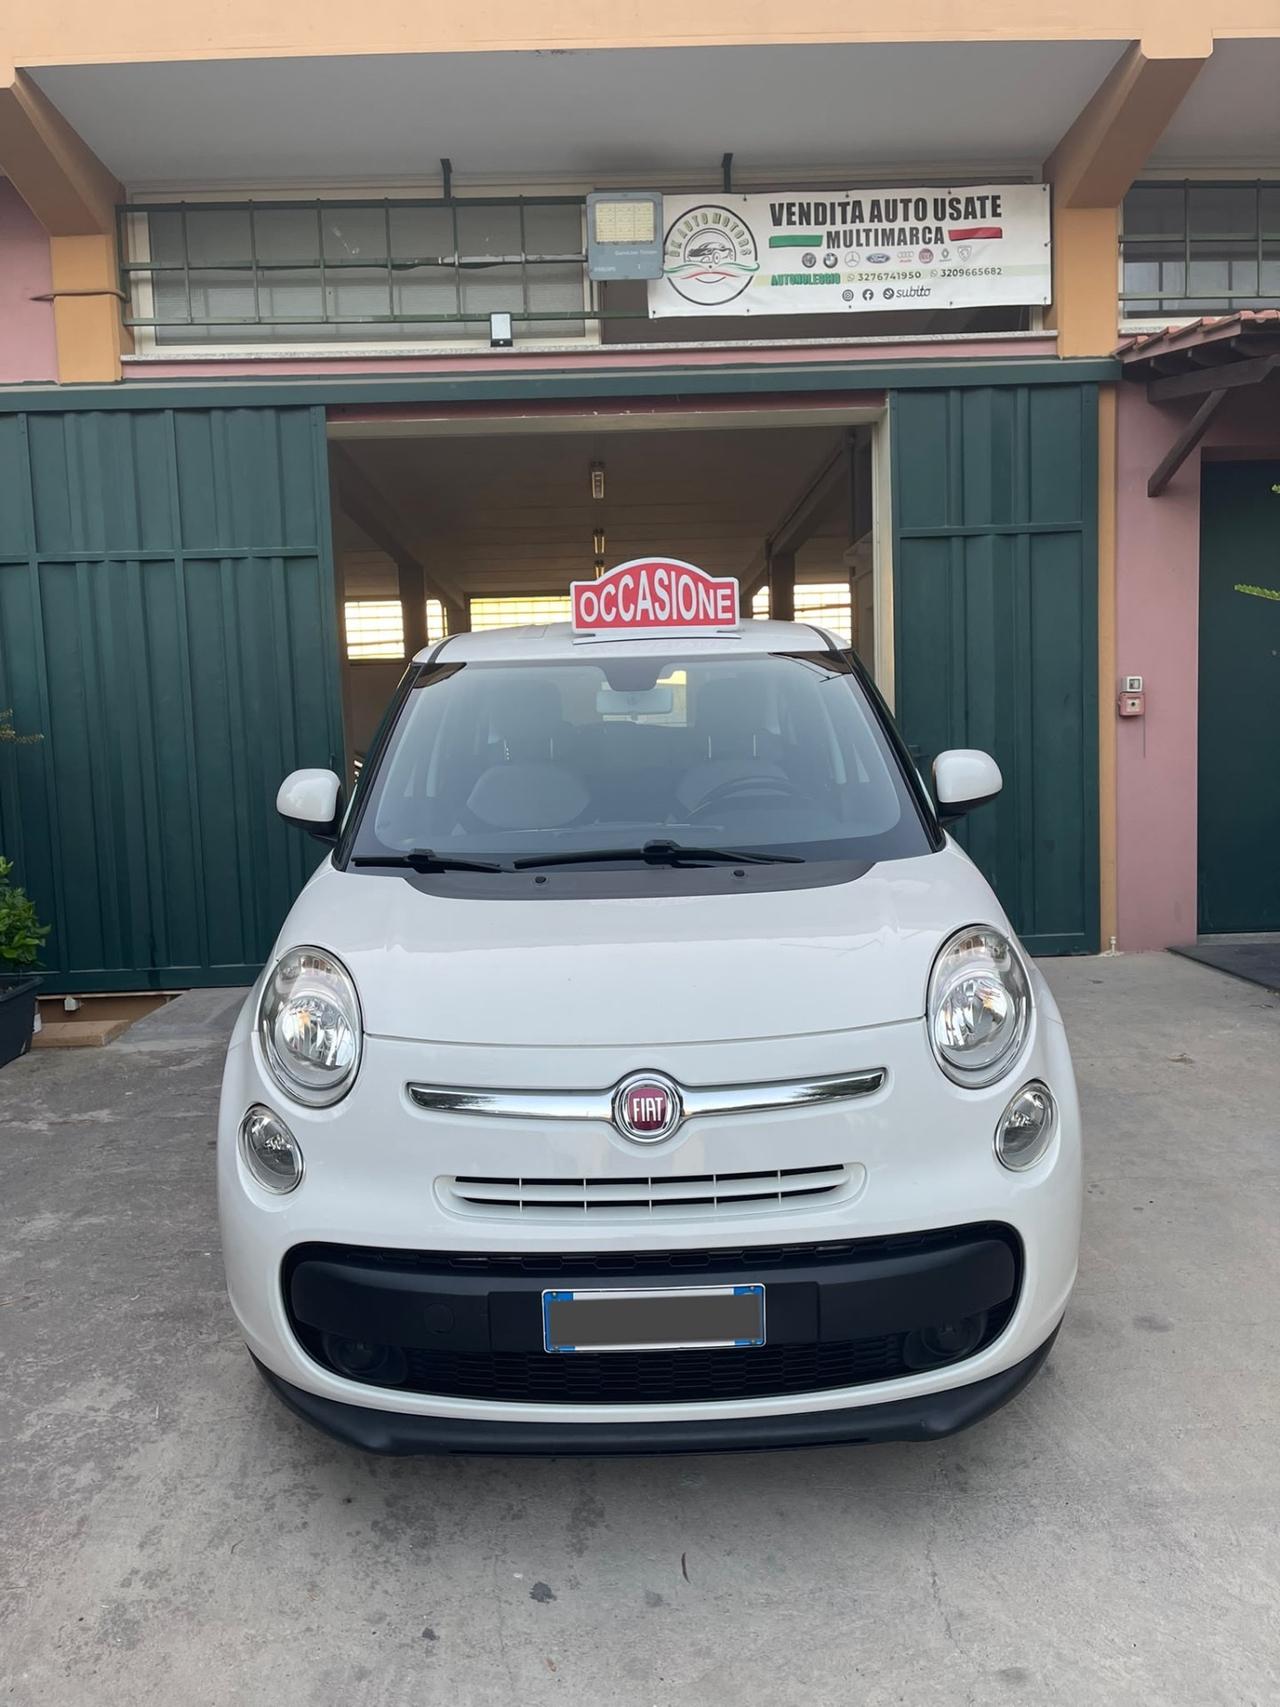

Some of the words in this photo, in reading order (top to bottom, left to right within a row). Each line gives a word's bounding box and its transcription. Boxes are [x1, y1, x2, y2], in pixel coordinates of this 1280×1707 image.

[770, 201, 865, 226] VENDITA
[869, 198, 927, 224] AUTO
[933, 195, 1002, 221] USATE
[679, 214, 709, 239] AUTO
[712, 212, 753, 256] MOTORS
[826, 226, 944, 249] MULTIMARCA
[857, 270, 922, 282] 3276741950
[940, 267, 1003, 278] 3209665682
[896, 285, 931, 298] subito
[580, 568, 732, 622] OCCASIONE
[633, 1097, 663, 1122] FIAT
